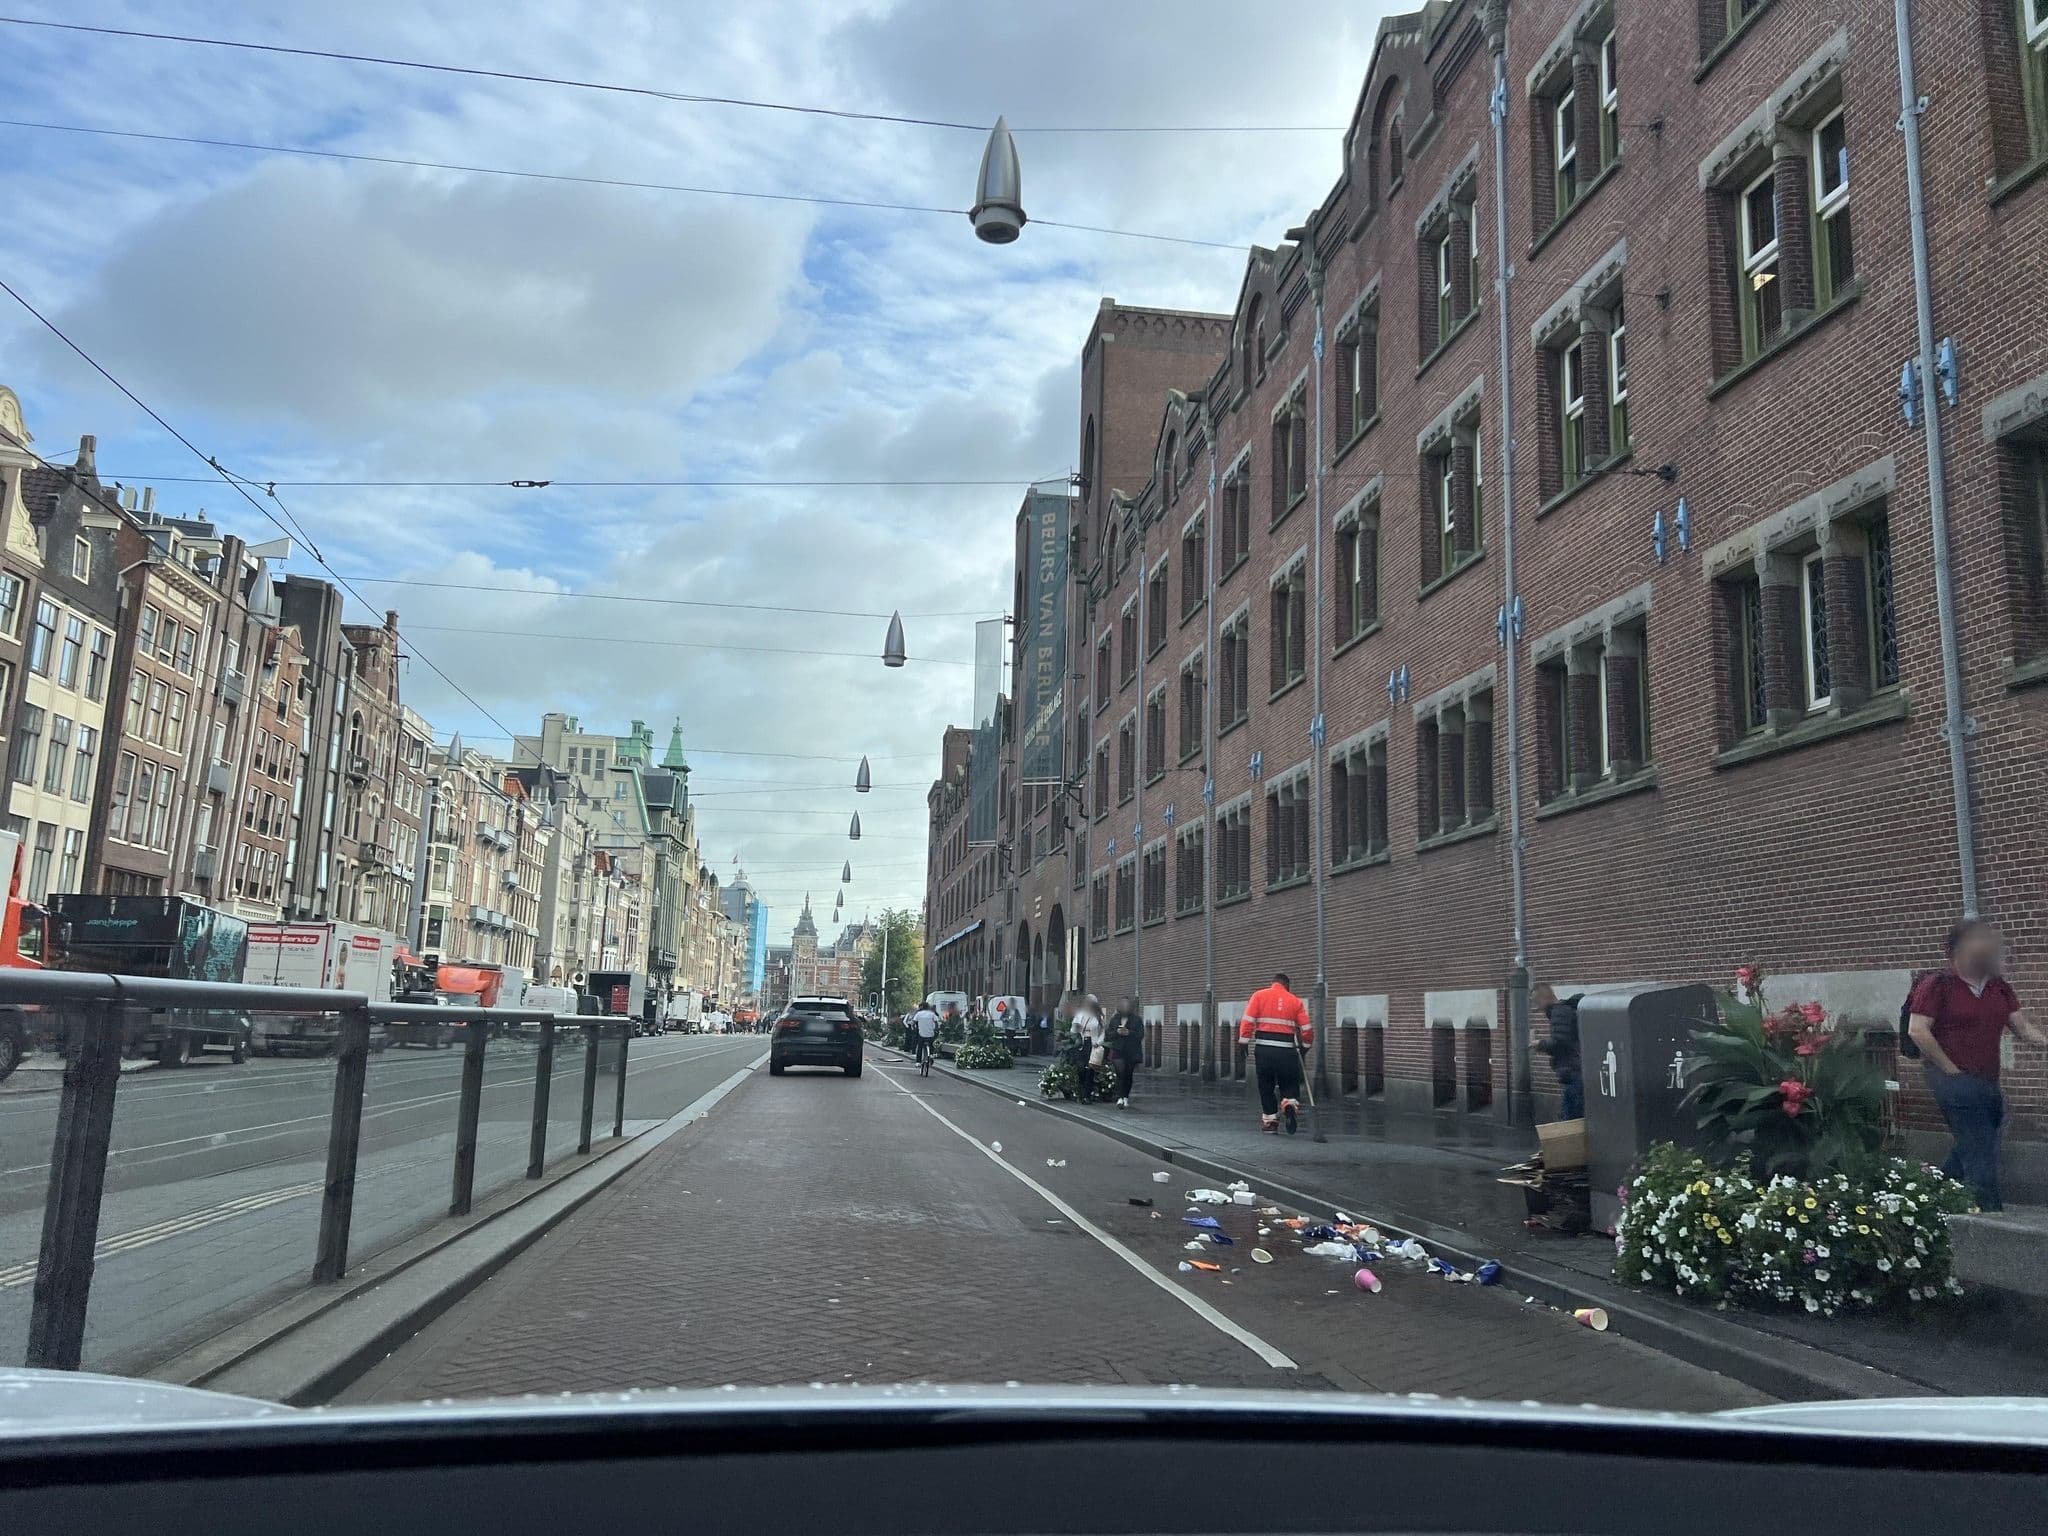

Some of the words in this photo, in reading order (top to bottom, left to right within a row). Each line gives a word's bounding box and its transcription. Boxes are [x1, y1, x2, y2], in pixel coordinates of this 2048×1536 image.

[1039, 511, 1057, 584] BEURS
[1038, 591, 1055, 638] VAN
[280, 934, 317, 944] Service
